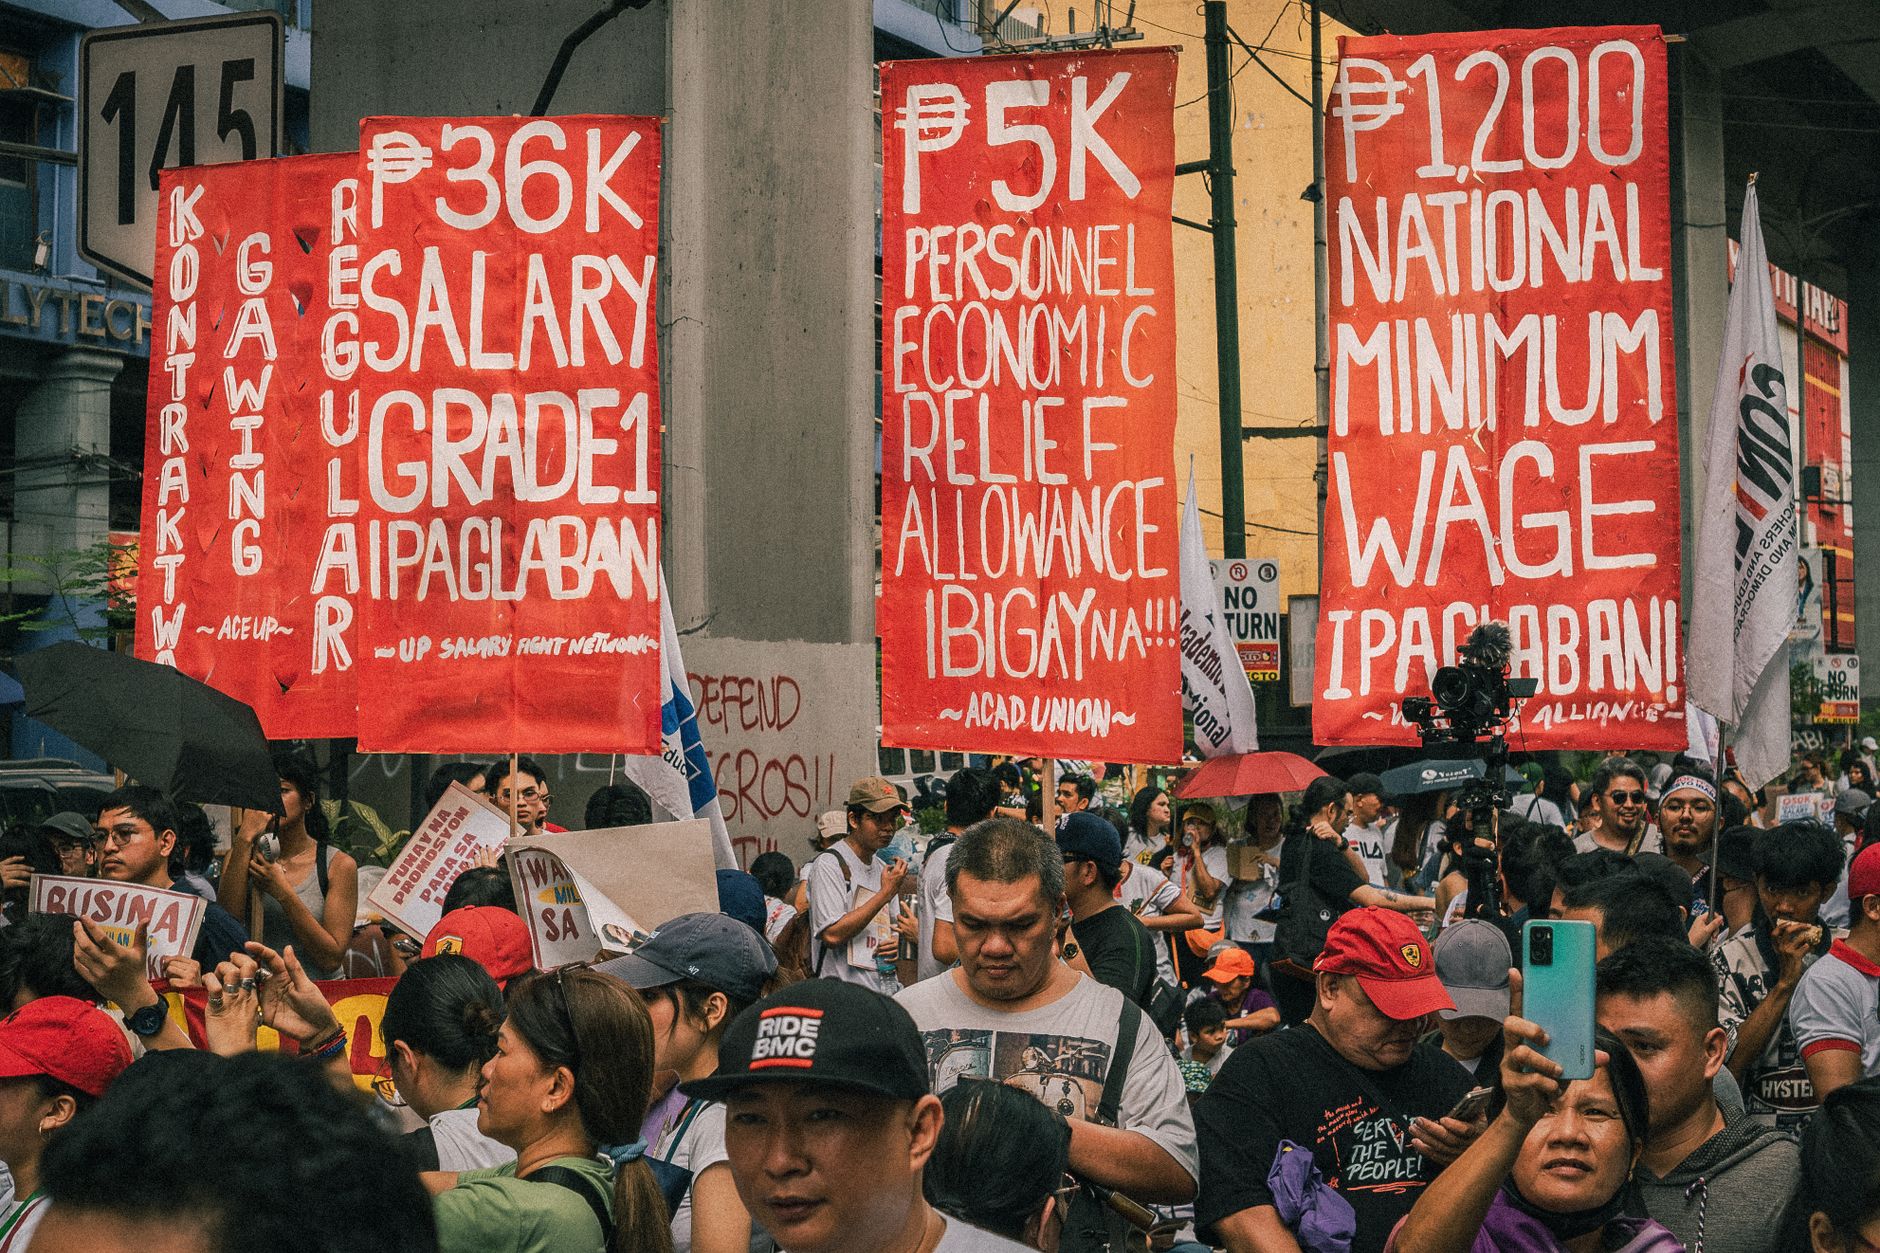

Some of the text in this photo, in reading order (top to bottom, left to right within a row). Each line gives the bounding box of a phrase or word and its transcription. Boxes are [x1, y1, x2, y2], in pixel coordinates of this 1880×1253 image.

[905, 223, 1155, 303] PERSONNEL
[1338, 183, 1663, 307] NATIONAL
[361, 246, 656, 373] SALARY
[894, 301, 1157, 394] ECONOMIC
[223, 231, 276, 577] GAWING
[1335, 309, 1664, 437] MINIMUM
[310, 178, 359, 675] REGULAR
[903, 390, 1128, 486] RELIEF
[895, 477, 1169, 581] ALLOWANCE
[1333, 440, 1658, 588] WAGE
[371, 515, 658, 602] IPAGLABAN
[1223, 586, 1258, 610] NO
[438, 634, 513, 660] SALARY
[1323, 595, 1678, 704] IPAGABAN!
[387, 809, 452, 887] TUNAY NA
[392, 806, 471, 906] PROMOSYON
[419, 832, 478, 903] PARA SA
[46, 885, 180, 944] BUSINA
[541, 907, 580, 942] SA
[752, 1036, 817, 1060] BMC
[757, 1015, 822, 1039] RIDE
[1346, 1154, 1423, 1181] PEOPLE!
[1351, 1141, 1388, 1163] THE
